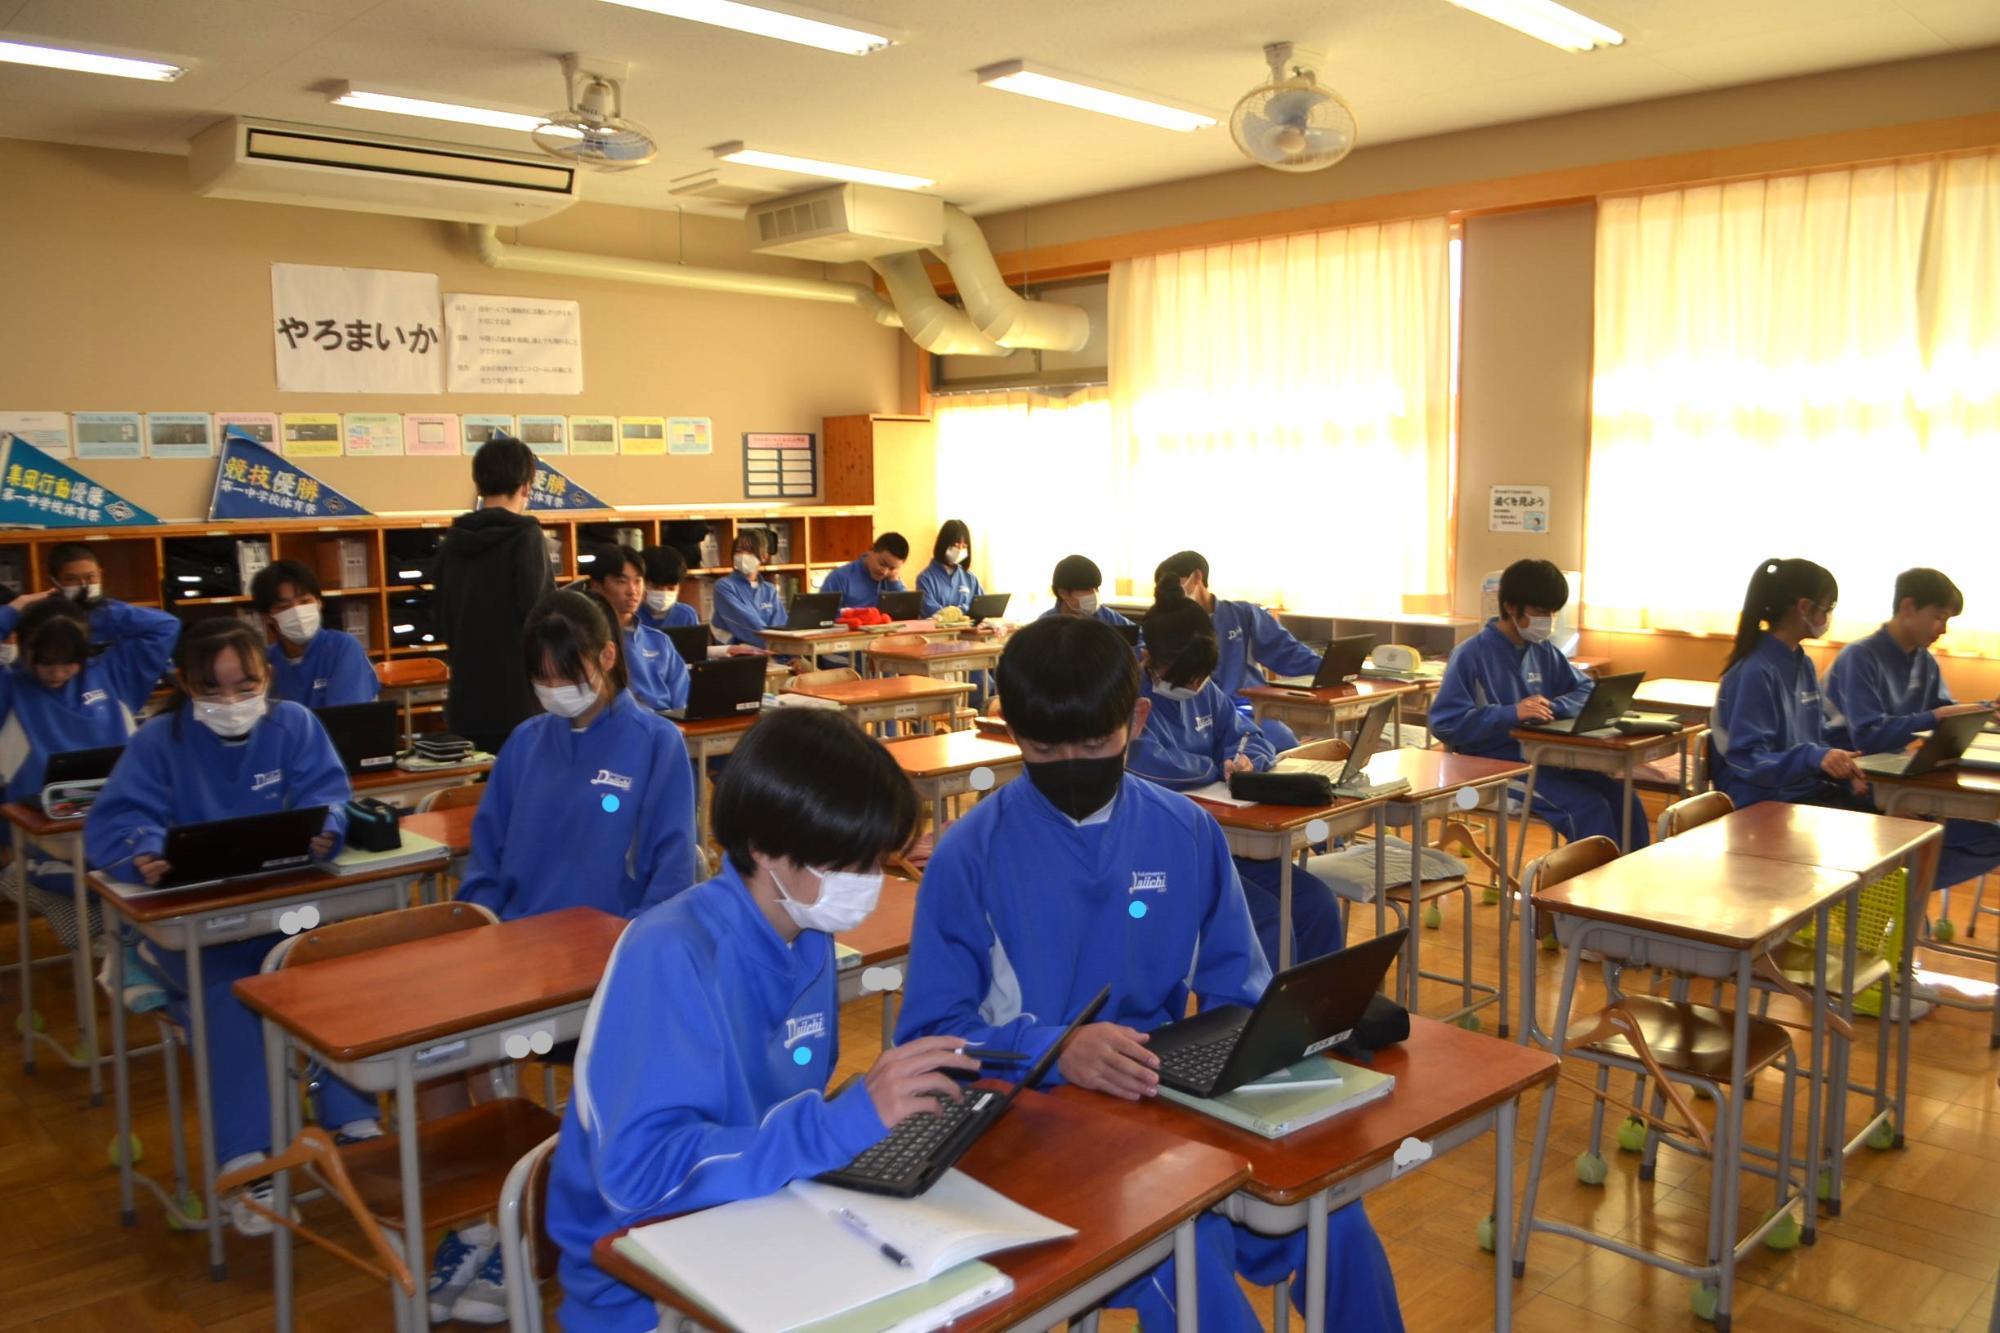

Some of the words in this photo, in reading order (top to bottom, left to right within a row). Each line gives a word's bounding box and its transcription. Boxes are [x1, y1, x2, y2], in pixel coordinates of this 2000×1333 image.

[276, 316, 438, 354] やろまいか
[6, 463, 104, 508] 集団行動優勝
[220, 479, 318, 515] 第一中学校体育祭
[223, 456, 320, 502] 競技優勝
[2, 487, 102, 522] 第一中学校体育祭
